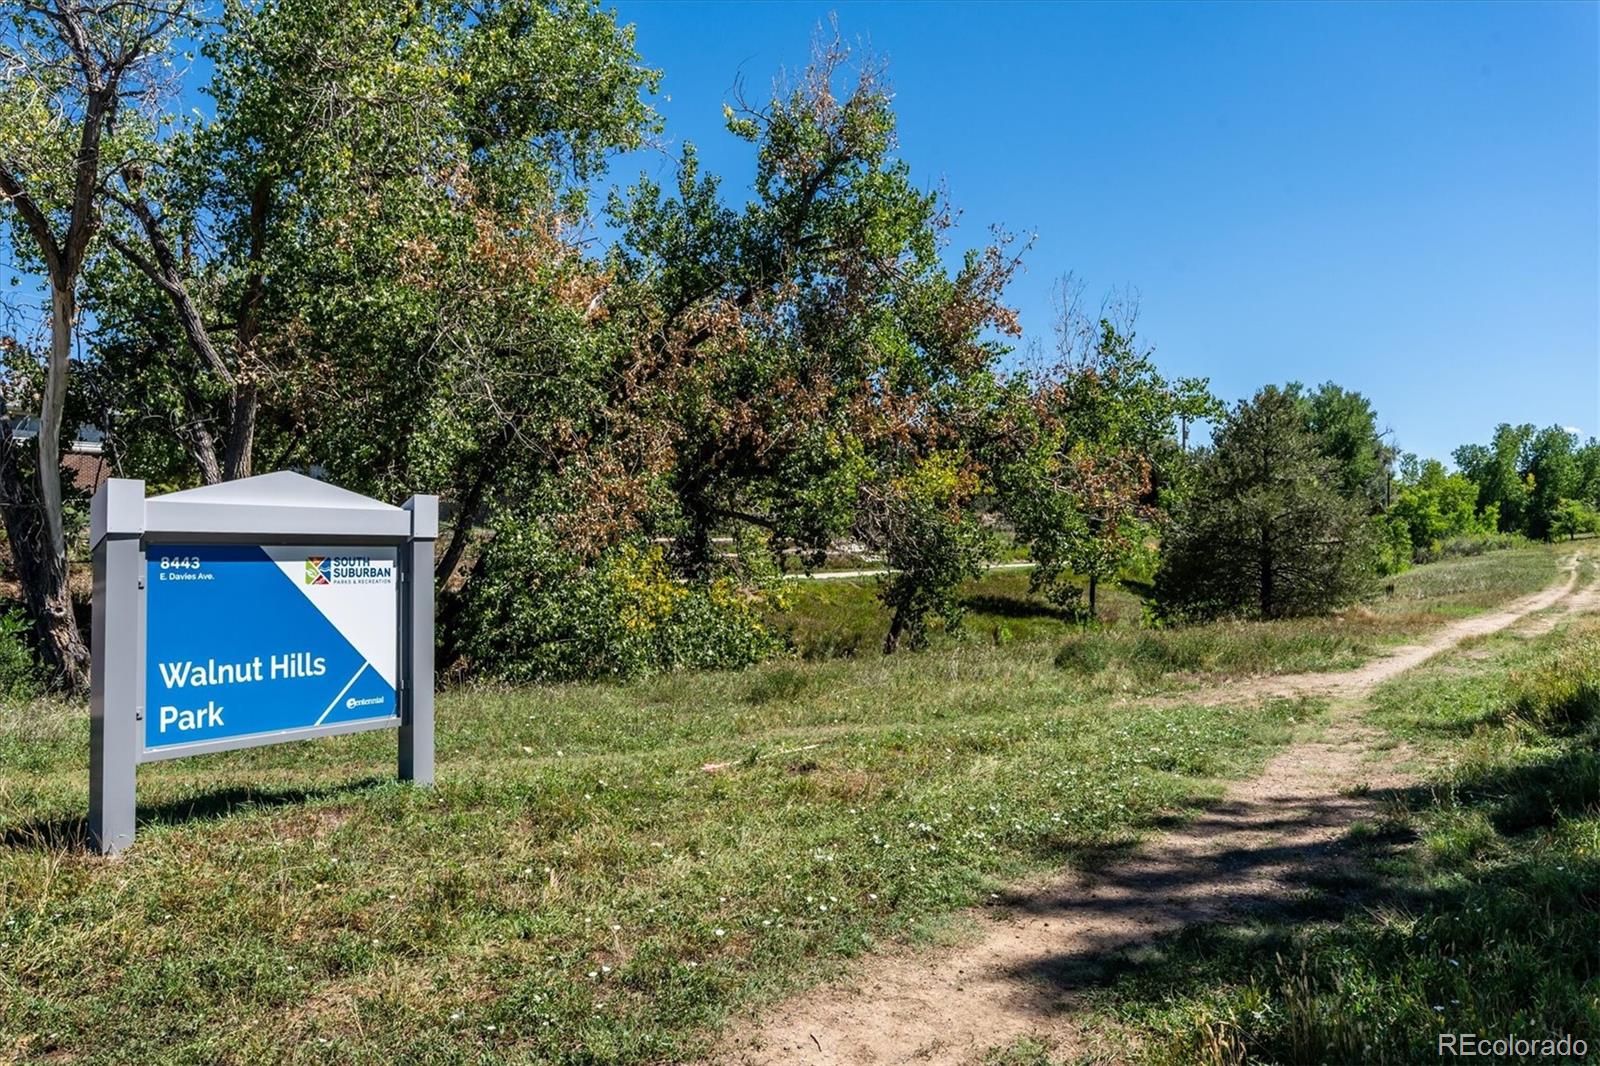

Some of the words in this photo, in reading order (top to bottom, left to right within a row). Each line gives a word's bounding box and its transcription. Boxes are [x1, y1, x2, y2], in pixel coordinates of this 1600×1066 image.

[160, 556, 200, 569] 8443
[333, 556, 370, 567] SOUTH
[159, 572, 168, 581] E.
[169, 572, 197, 581] Davies
[198, 572, 215, 580] Ave.
[333, 567, 391, 578] SUBURBAN
[159, 657, 263, 689] Walnut
[271, 652, 326, 680] Hills
[159, 701, 224, 733] Park
